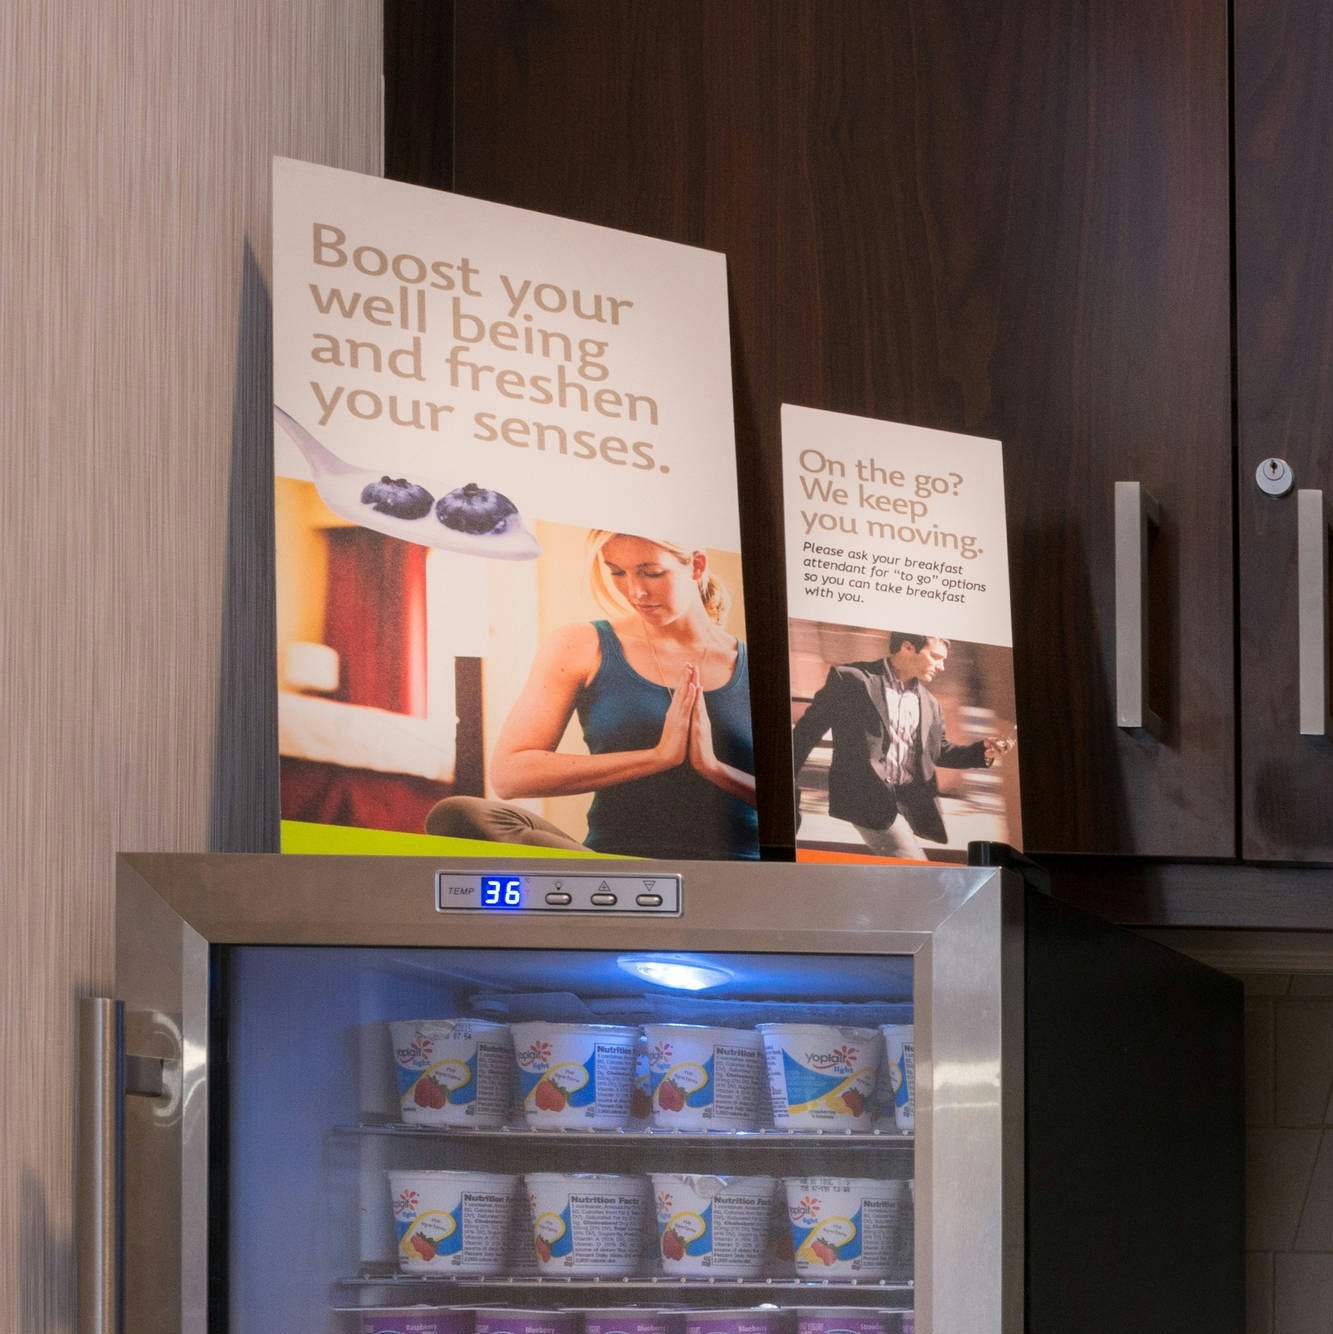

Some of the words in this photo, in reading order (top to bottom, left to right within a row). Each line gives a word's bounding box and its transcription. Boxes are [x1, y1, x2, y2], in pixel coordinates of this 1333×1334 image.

[312, 222, 482, 297] Boost
[500, 274, 634, 326] your
[309, 284, 426, 333] well
[453, 296, 609, 382] being
[310, 332, 426, 382] and
[445, 346, 659, 425] freshen
[309, 381, 454, 432] your
[473, 411, 671, 475] senses.
[799, 449, 845, 478] On
[855, 458, 905, 487] the
[914, 473, 964, 498] go?
[800, 475, 848, 505] We
[858, 484, 928, 523] keep
[800, 510, 858, 535] you
[866, 519, 983, 560] moving.
[803, 541, 844, 557] Please
[848, 548, 868, 561] ask
[872, 553, 901, 566] your
[904, 556, 964, 575] breakfast
[803, 558, 866, 575] attendant
[870, 565, 889, 578] for
[941, 577, 987, 593] options
[803, 573, 818, 582] so
[821, 574, 845, 586] you
[848, 578, 871, 590] can
[875, 581, 903, 594] take
[906, 584, 966, 604] breakfast
[804, 586, 834, 599] with
[837, 590, 864, 604] you.
[448, 887, 475, 896] TEMP
[485, 880, 520, 905] 36
